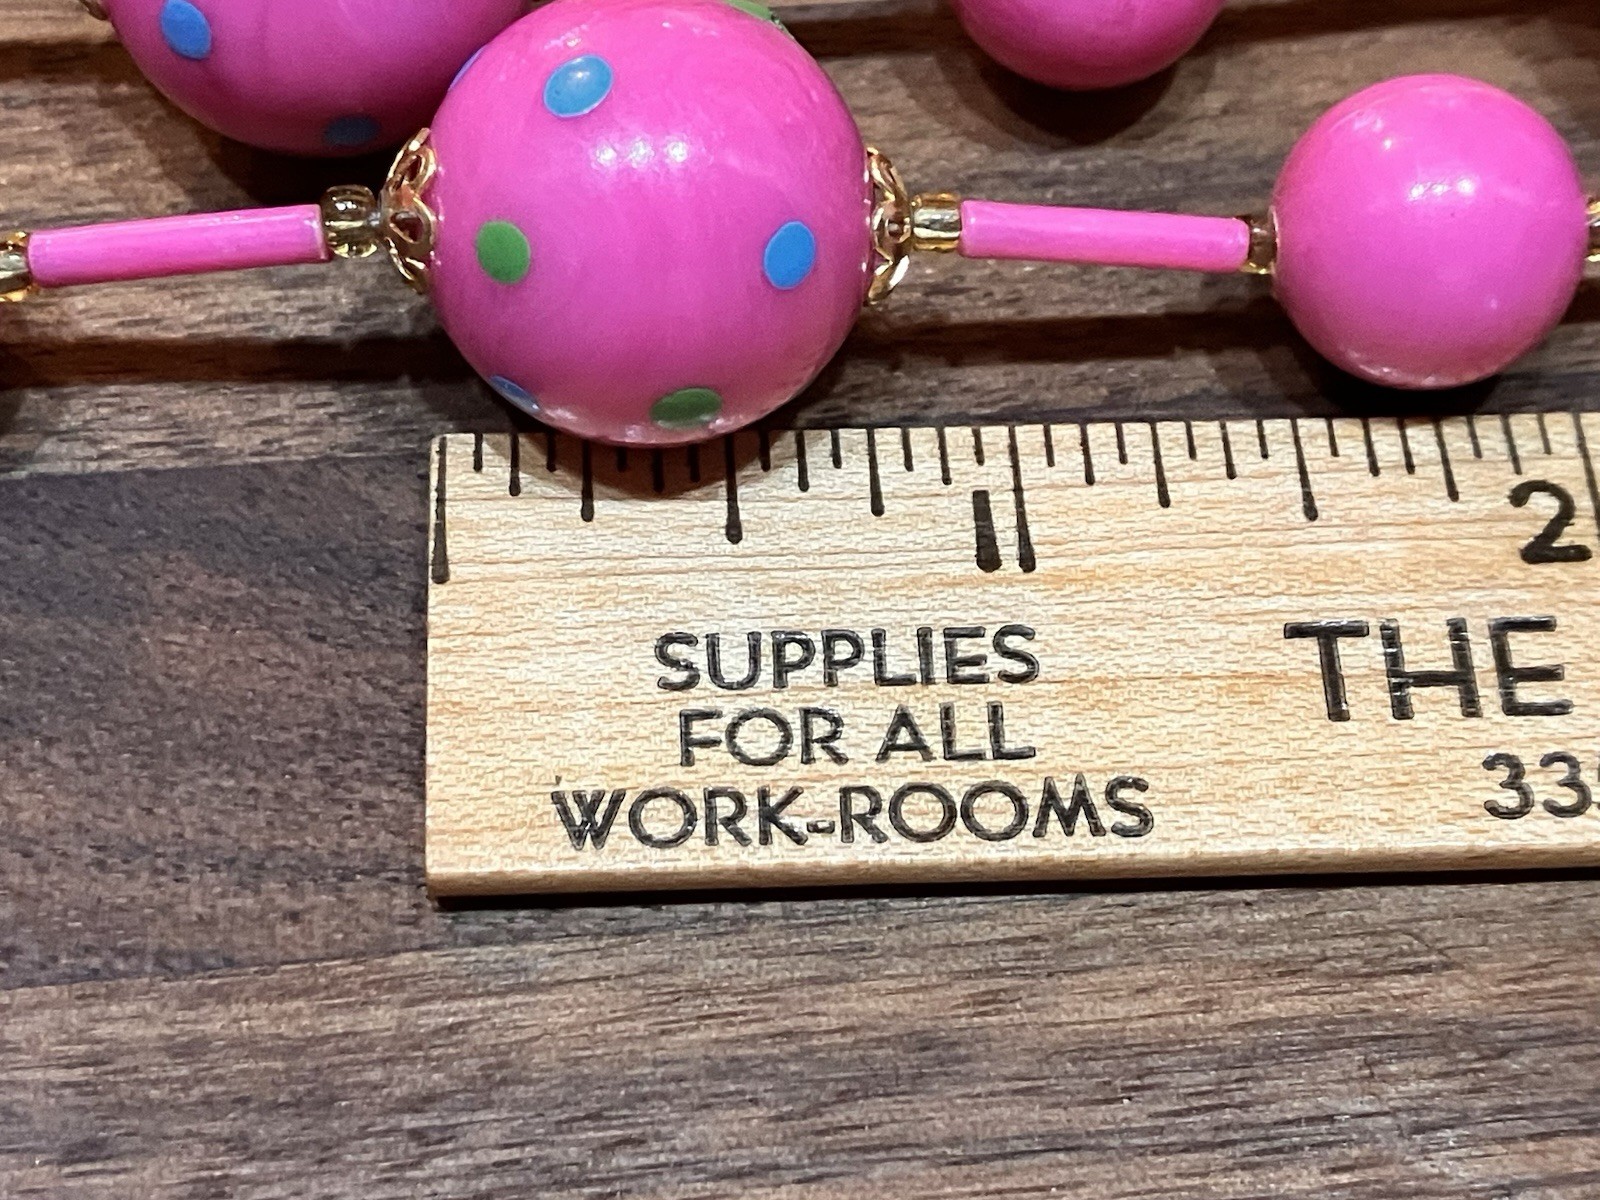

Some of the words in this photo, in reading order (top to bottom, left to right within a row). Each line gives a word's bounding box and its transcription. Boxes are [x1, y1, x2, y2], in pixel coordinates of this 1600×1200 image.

[1508, 479, 1593, 565] 2
[654, 624, 1040, 692] SUPPLIES
[1283, 615, 1575, 723] THE
[678, 707, 849, 767] FOR
[875, 701, 1037, 764] ALL
[550, 773, 1155, 850] WORK-ROOMS
[1481, 750, 1600, 820] 33
